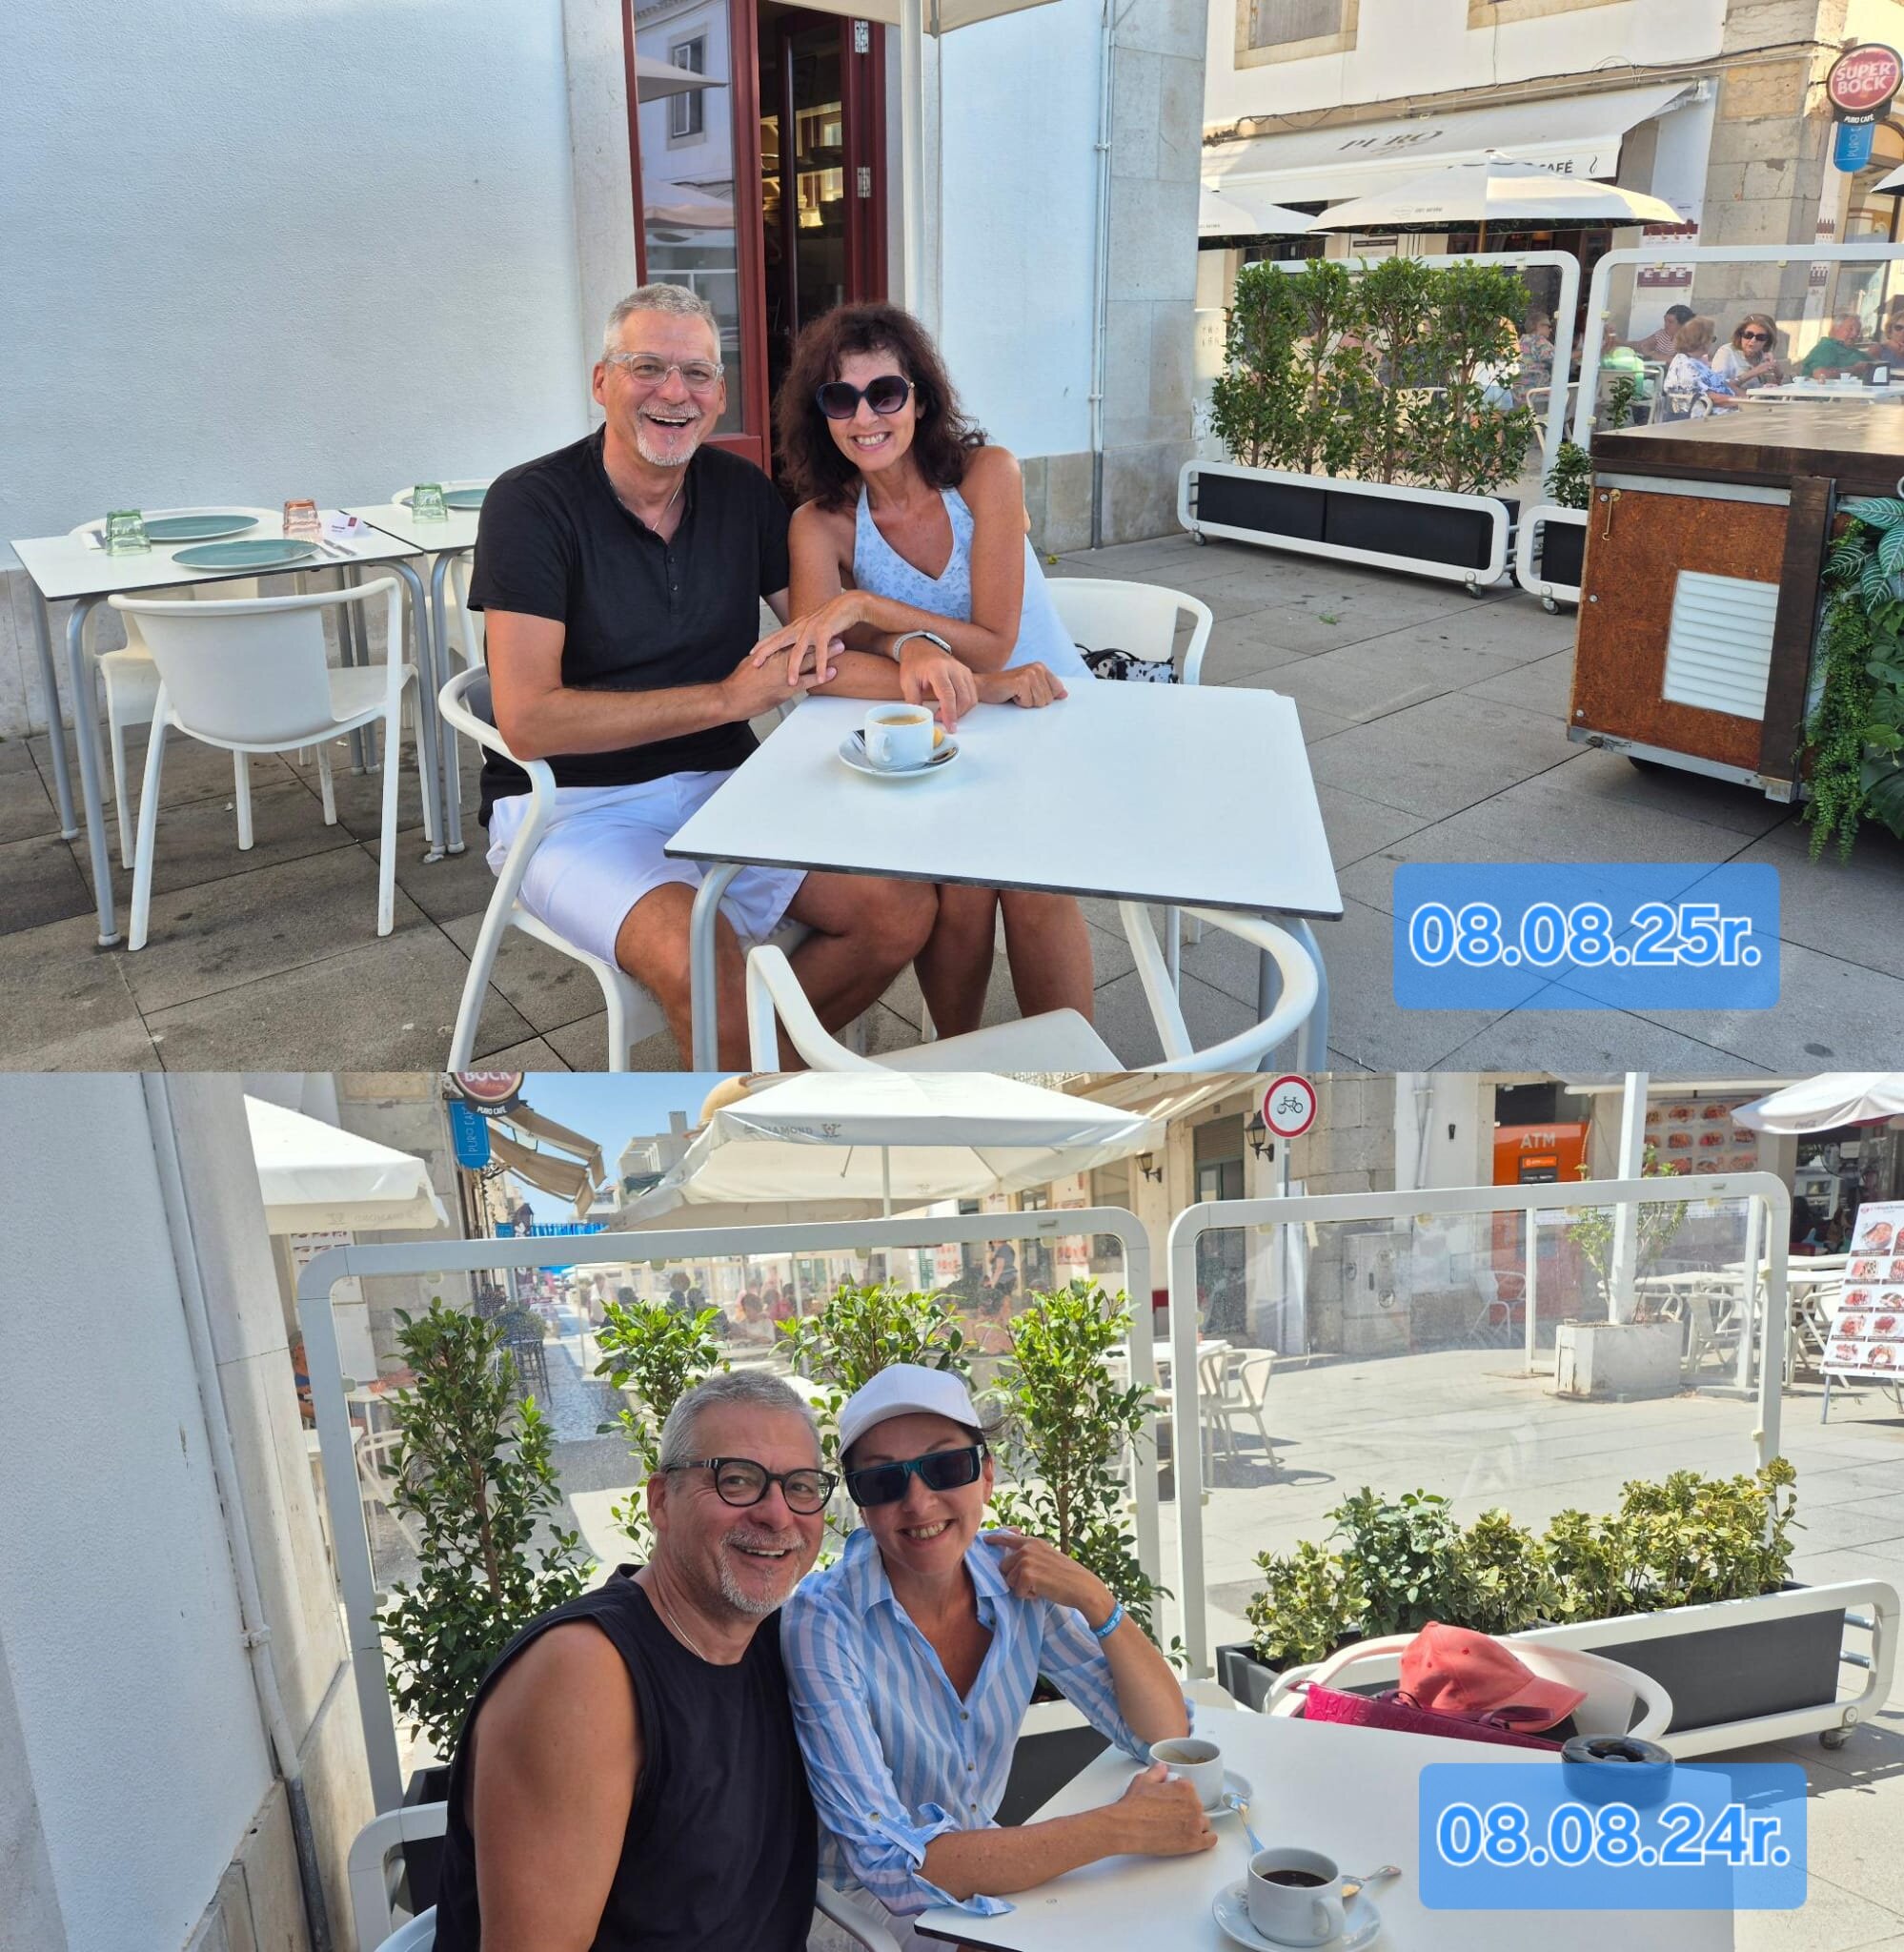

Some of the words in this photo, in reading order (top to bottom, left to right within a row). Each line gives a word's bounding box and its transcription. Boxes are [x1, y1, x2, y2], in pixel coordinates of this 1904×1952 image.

[1836, 61, 1893, 82] SUPER
[1837, 75, 1888, 95] BOCK
[1539, 159, 1574, 173] AFÉ
[465, 1128, 479, 1152] PURO
[1520, 1131, 1555, 1149] ATM
